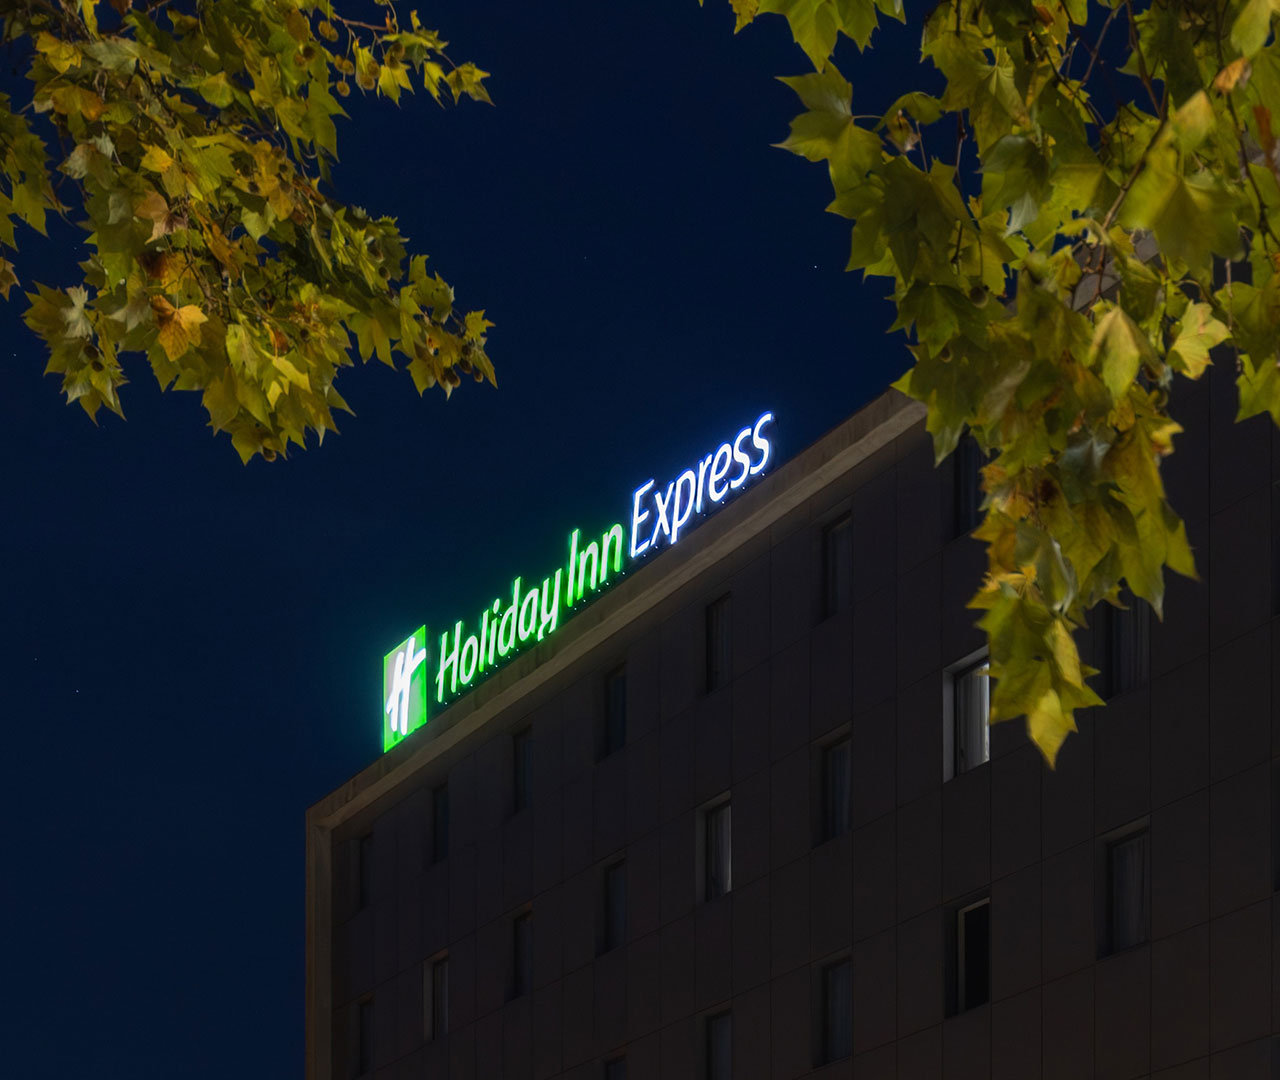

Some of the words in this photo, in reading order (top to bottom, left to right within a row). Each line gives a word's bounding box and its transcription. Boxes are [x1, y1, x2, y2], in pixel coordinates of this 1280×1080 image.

[436, 568, 562, 702] Holiday
[567, 523, 624, 607] Inn
[630, 411, 772, 558] Express
